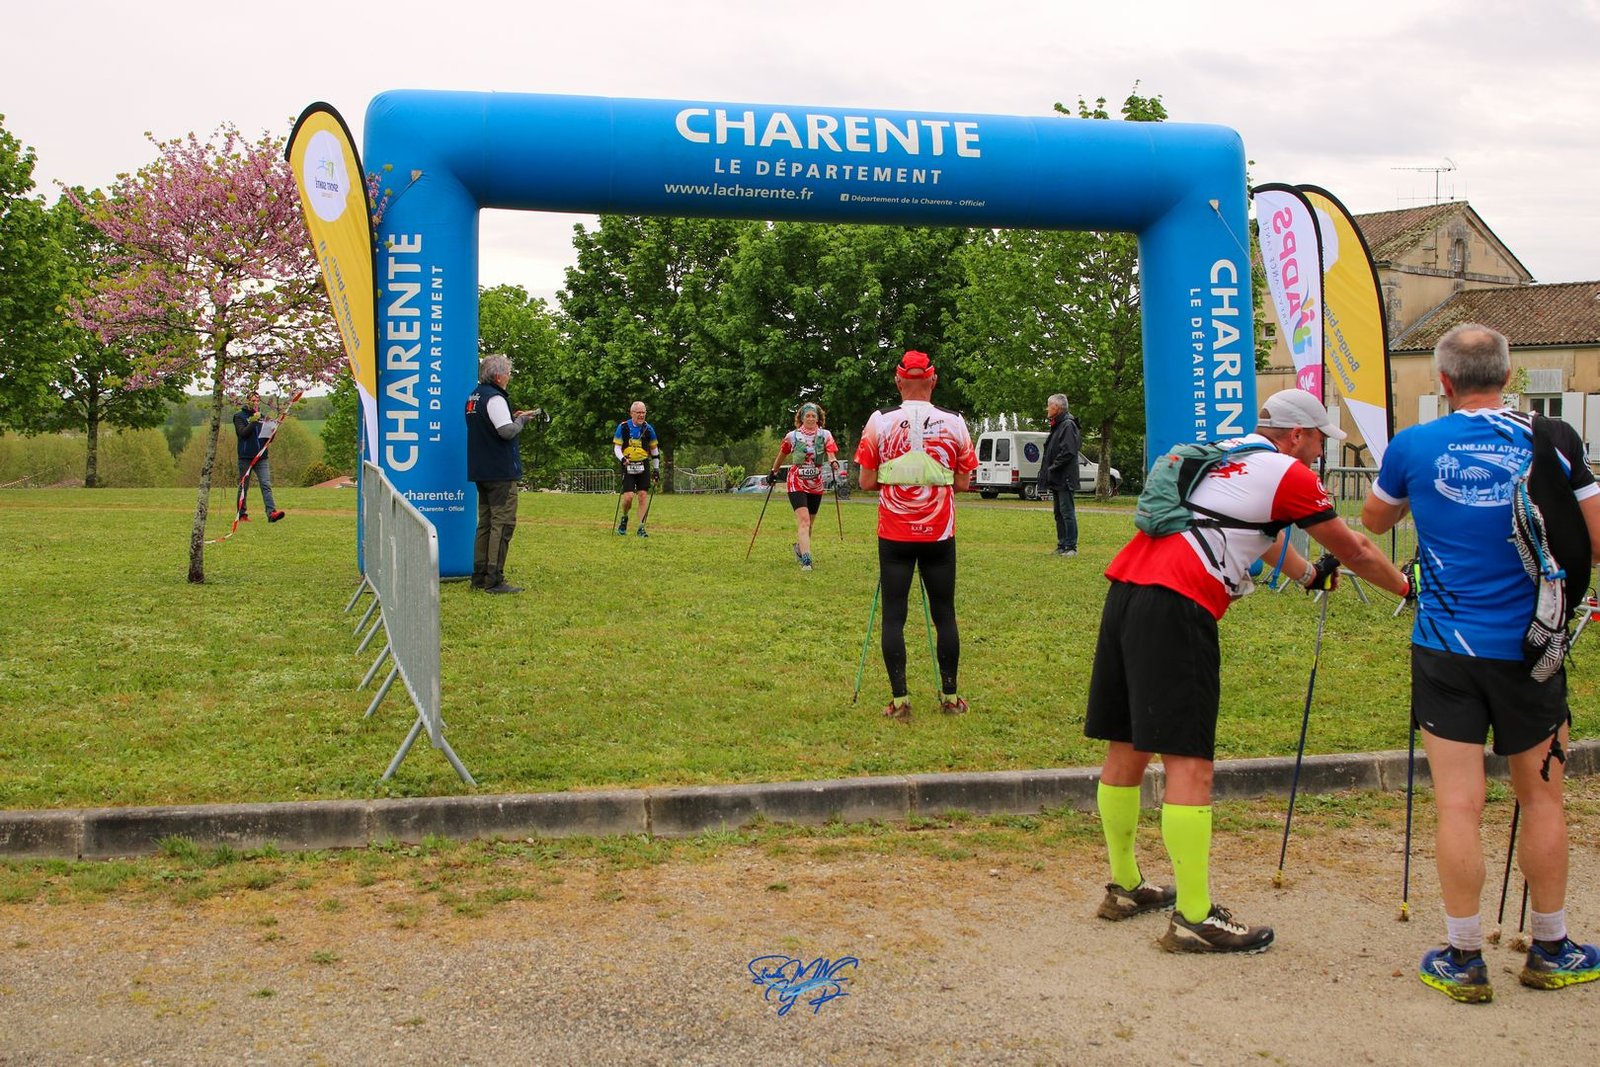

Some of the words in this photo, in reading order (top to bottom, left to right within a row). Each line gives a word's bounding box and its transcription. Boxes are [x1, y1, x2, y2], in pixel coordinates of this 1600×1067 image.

[675, 107, 981, 159] CHARENTE
[714, 158, 741, 175] LE
[756, 159, 942, 185] DÉPARTEMENT
[664, 182, 814, 200] www.lacharente.fr
[851, 194, 899, 205] Département
[901, 196, 911, 204] de
[912, 196, 919, 204] la
[920, 197, 953, 206] Charente
[959, 199, 986, 208] Officiel
[1190, 288, 1202, 307] LE
[427, 265, 443, 410] DÉPARTEMENT
[1210, 259, 1244, 435] CHAREN
[385, 234, 422, 472] CHARENTE
[1191, 317, 1207, 441] DÉPARTEMEN
[429, 421, 441, 442] LE
[403, 489, 465, 501] charente.fr
